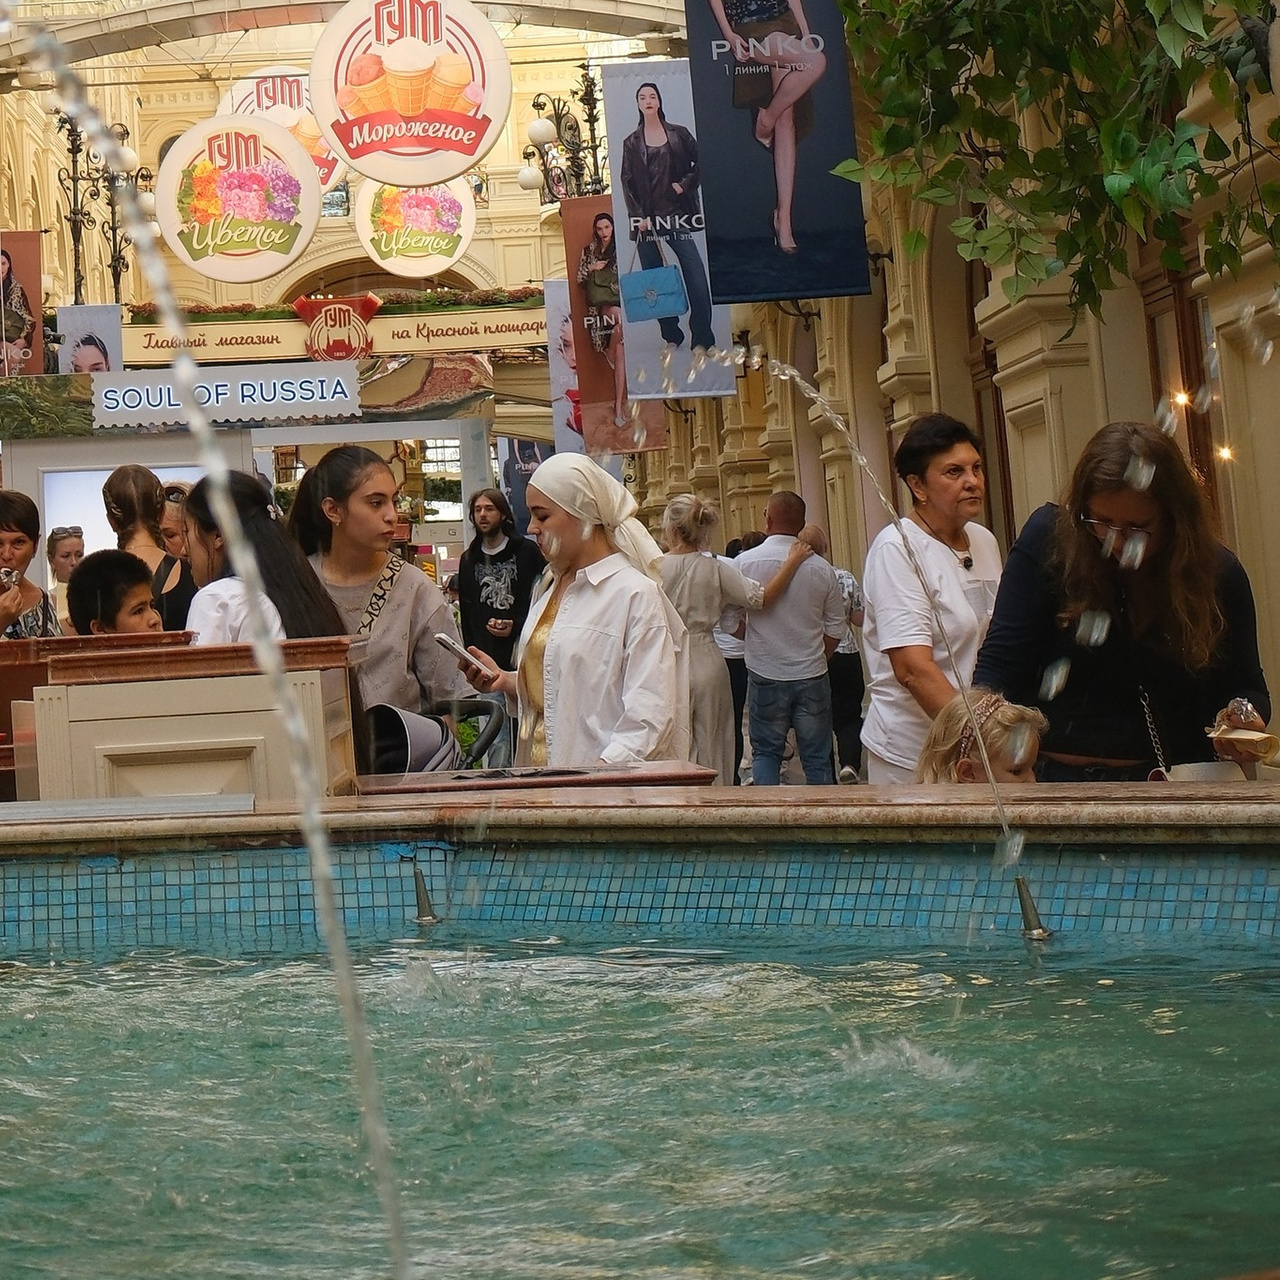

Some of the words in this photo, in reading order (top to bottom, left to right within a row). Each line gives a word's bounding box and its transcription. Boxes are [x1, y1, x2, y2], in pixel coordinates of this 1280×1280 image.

[711, 34, 825, 60] PINKO
[724, 64, 730, 75] 1
[735, 64, 770, 75] линия
[774, 60, 779, 72] 1
[255, 77, 304, 111] ГУМ
[348, 121, 476, 149] Мороженое
[207, 131, 262, 173] ГУМ
[188, 208, 289, 256] Цветы
[630, 214, 705, 232] PINKO
[379, 223, 453, 257] Цветы
[323, 307, 352, 328] ГУМ
[583, 313, 622, 328] PIN
[142, 333, 207, 349] Главный
[215, 333, 282, 347] магазин
[391, 329, 411, 340] на
[415, 321, 480, 342] Красной
[102, 385, 182, 411] SOUL
[193, 381, 230, 407] OF
[239, 377, 350, 405] RUSSIA
